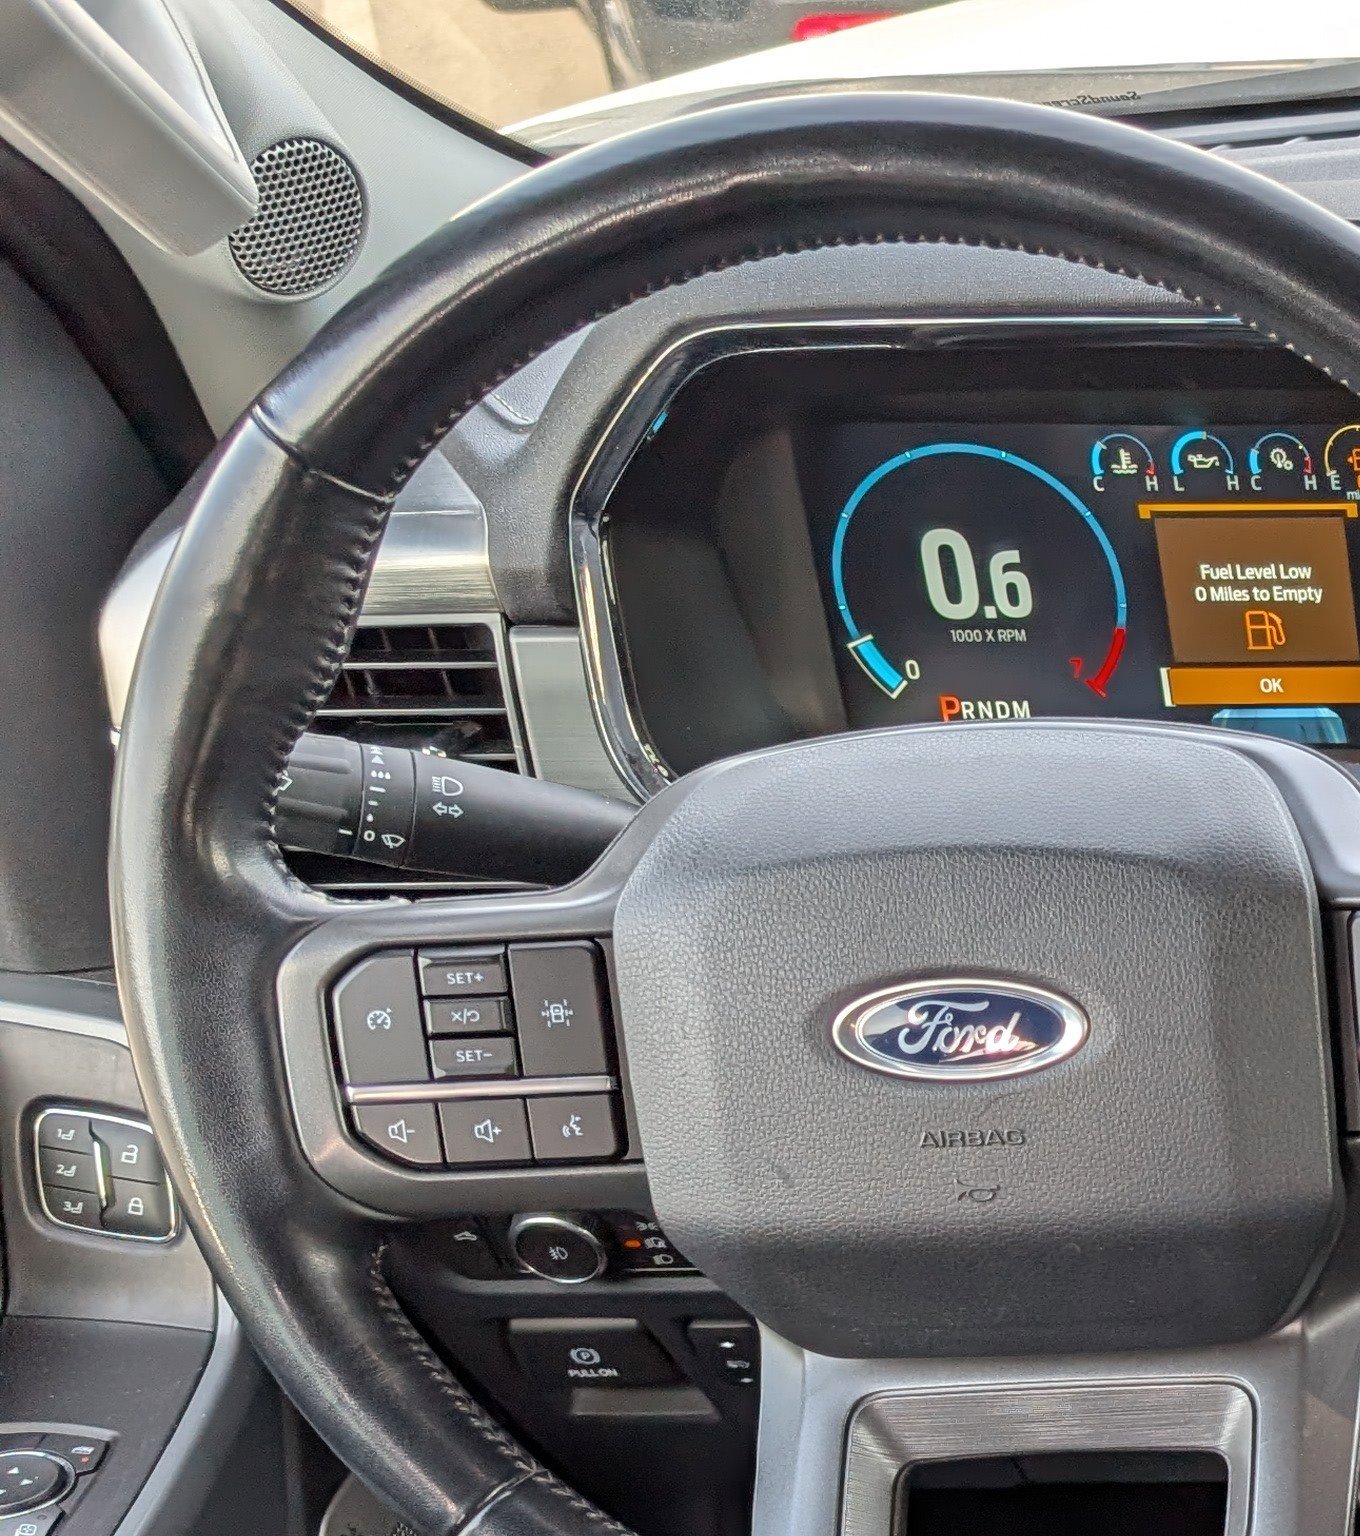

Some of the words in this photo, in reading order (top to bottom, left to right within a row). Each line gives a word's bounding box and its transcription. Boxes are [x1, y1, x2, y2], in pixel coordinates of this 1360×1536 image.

[1093, 475, 1105, 491] C
[1145, 475, 1159, 491] H
[1173, 475, 1185, 491] L
[1226, 475, 1240, 491] H
[1250, 475, 1262, 491] C
[1304, 475, 1318, 491] H
[1330, 475, 1342, 491] E
[1346, 490, 1360, 500] mi
[921, 528, 1033, 620] 0.6
[1199, 563, 1234, 580] Fuel
[1235, 563, 1278, 580] Level
[1278, 563, 1312, 580] Low
[1194, 586, 1207, 602] 0
[1210, 585, 1251, 602] Miles
[1252, 586, 1271, 602] to
[1272, 585, 1323, 604] Empty
[950, 629, 983, 642] 1000
[985, 629, 995, 642] X
[997, 629, 1027, 642] RPM
[904, 659, 920, 680] 0
[1069, 657, 1084, 678] 7
[1259, 677, 1284, 694] OK
[446, 972, 484, 985] SET+
[898, 1000, 1022, 1054] Ford
[920, 1128, 1027, 1148] AIRBAG
